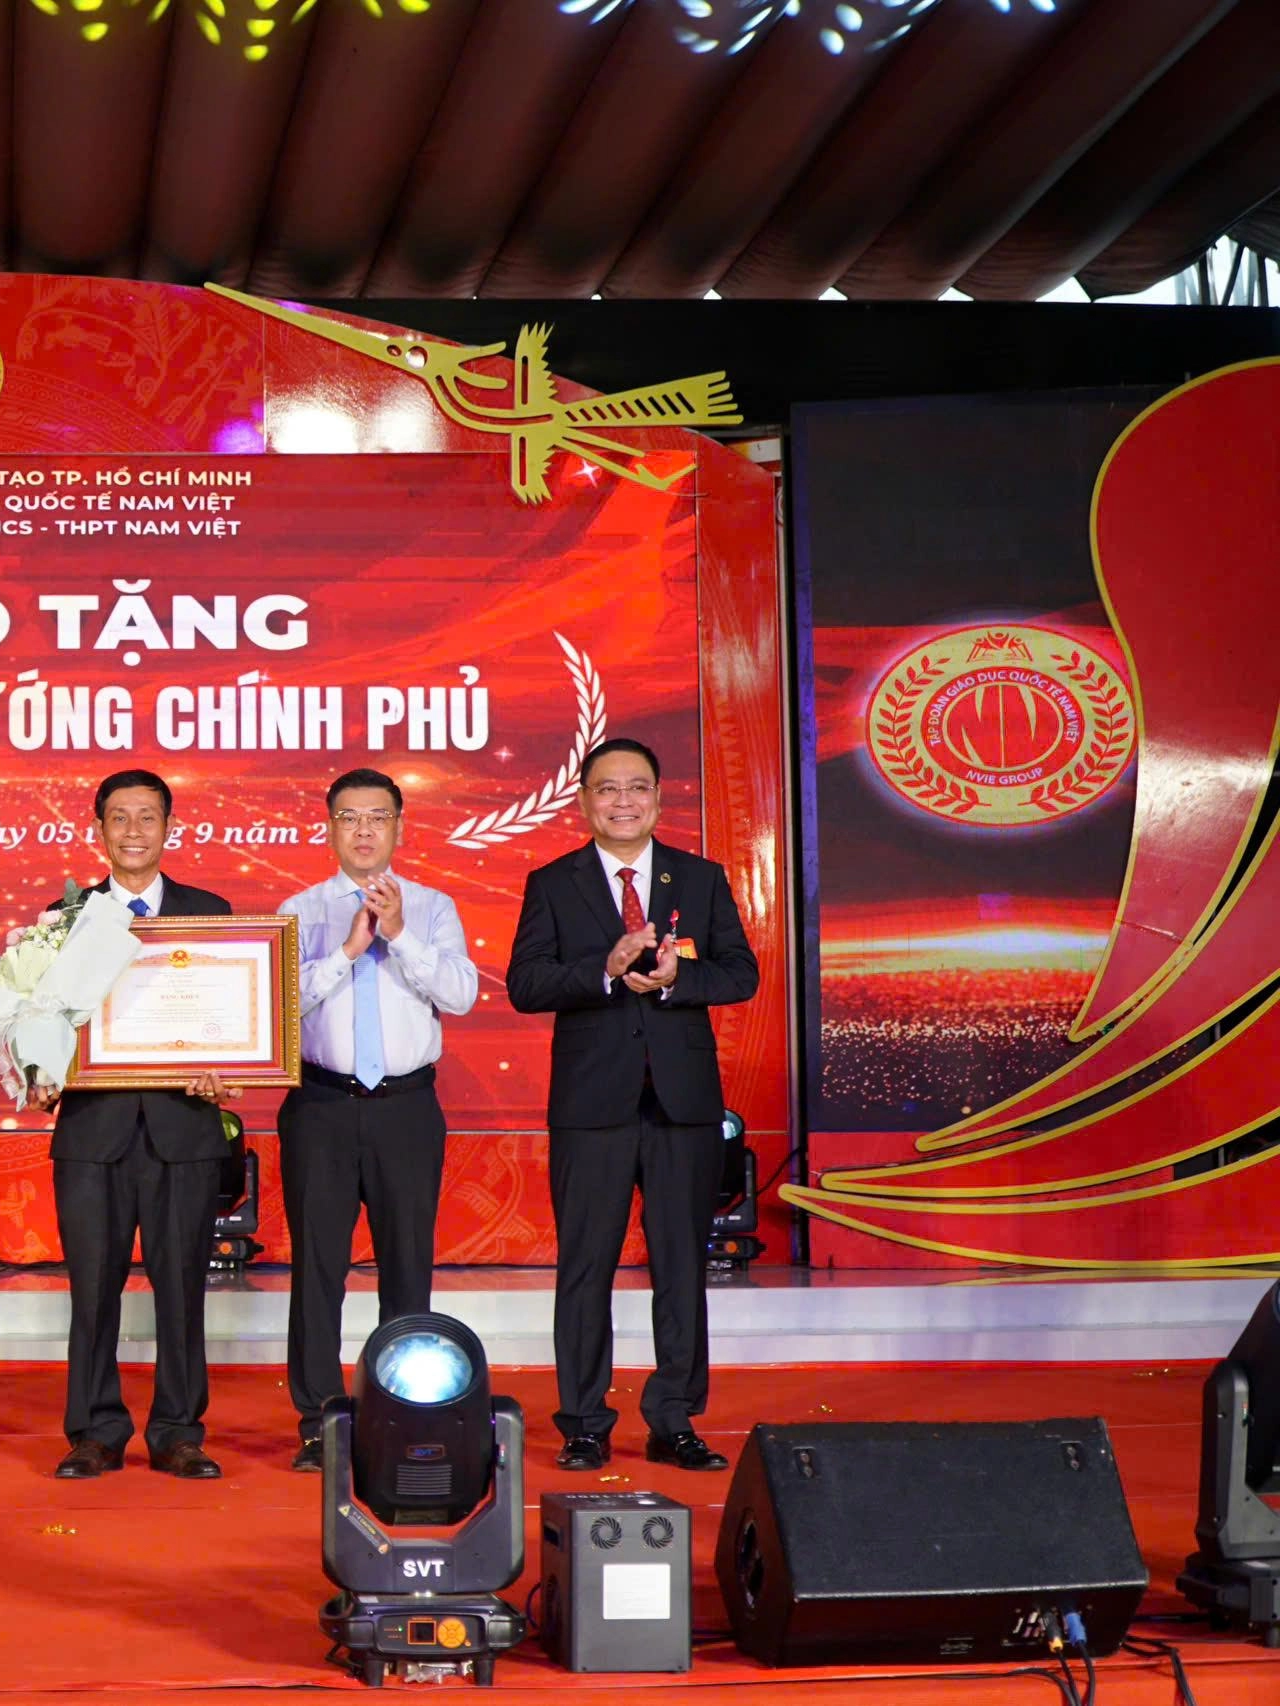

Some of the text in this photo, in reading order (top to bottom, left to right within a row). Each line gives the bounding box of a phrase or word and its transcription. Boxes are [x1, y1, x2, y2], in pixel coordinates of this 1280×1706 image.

[52, 471, 88, 485] TP.
[96, 467, 131, 485] HỒ
[138, 468, 180, 485] CHÍ
[188, 471, 252, 485] MINH
[5, 492, 75, 512] QUỐC
[83, 491, 111, 510] TẾ
[119, 496, 174, 510] NAM
[182, 492, 235, 513] VIỆT
[55, 520, 118, 534] THPT
[125, 520, 180, 534] NAM
[187, 517, 241, 538] VIỆT
[39, 579, 308, 666] TẶNG
[156, 670, 343, 750] CHÍNH
[367, 665, 489, 750] PHỦ
[999, 767, 1044, 785] GROUP
[37, 822, 75, 844] 05
[195, 822, 214, 844] 9
[223, 819, 300, 844] năm
[403, 1559, 445, 1577] SVT
